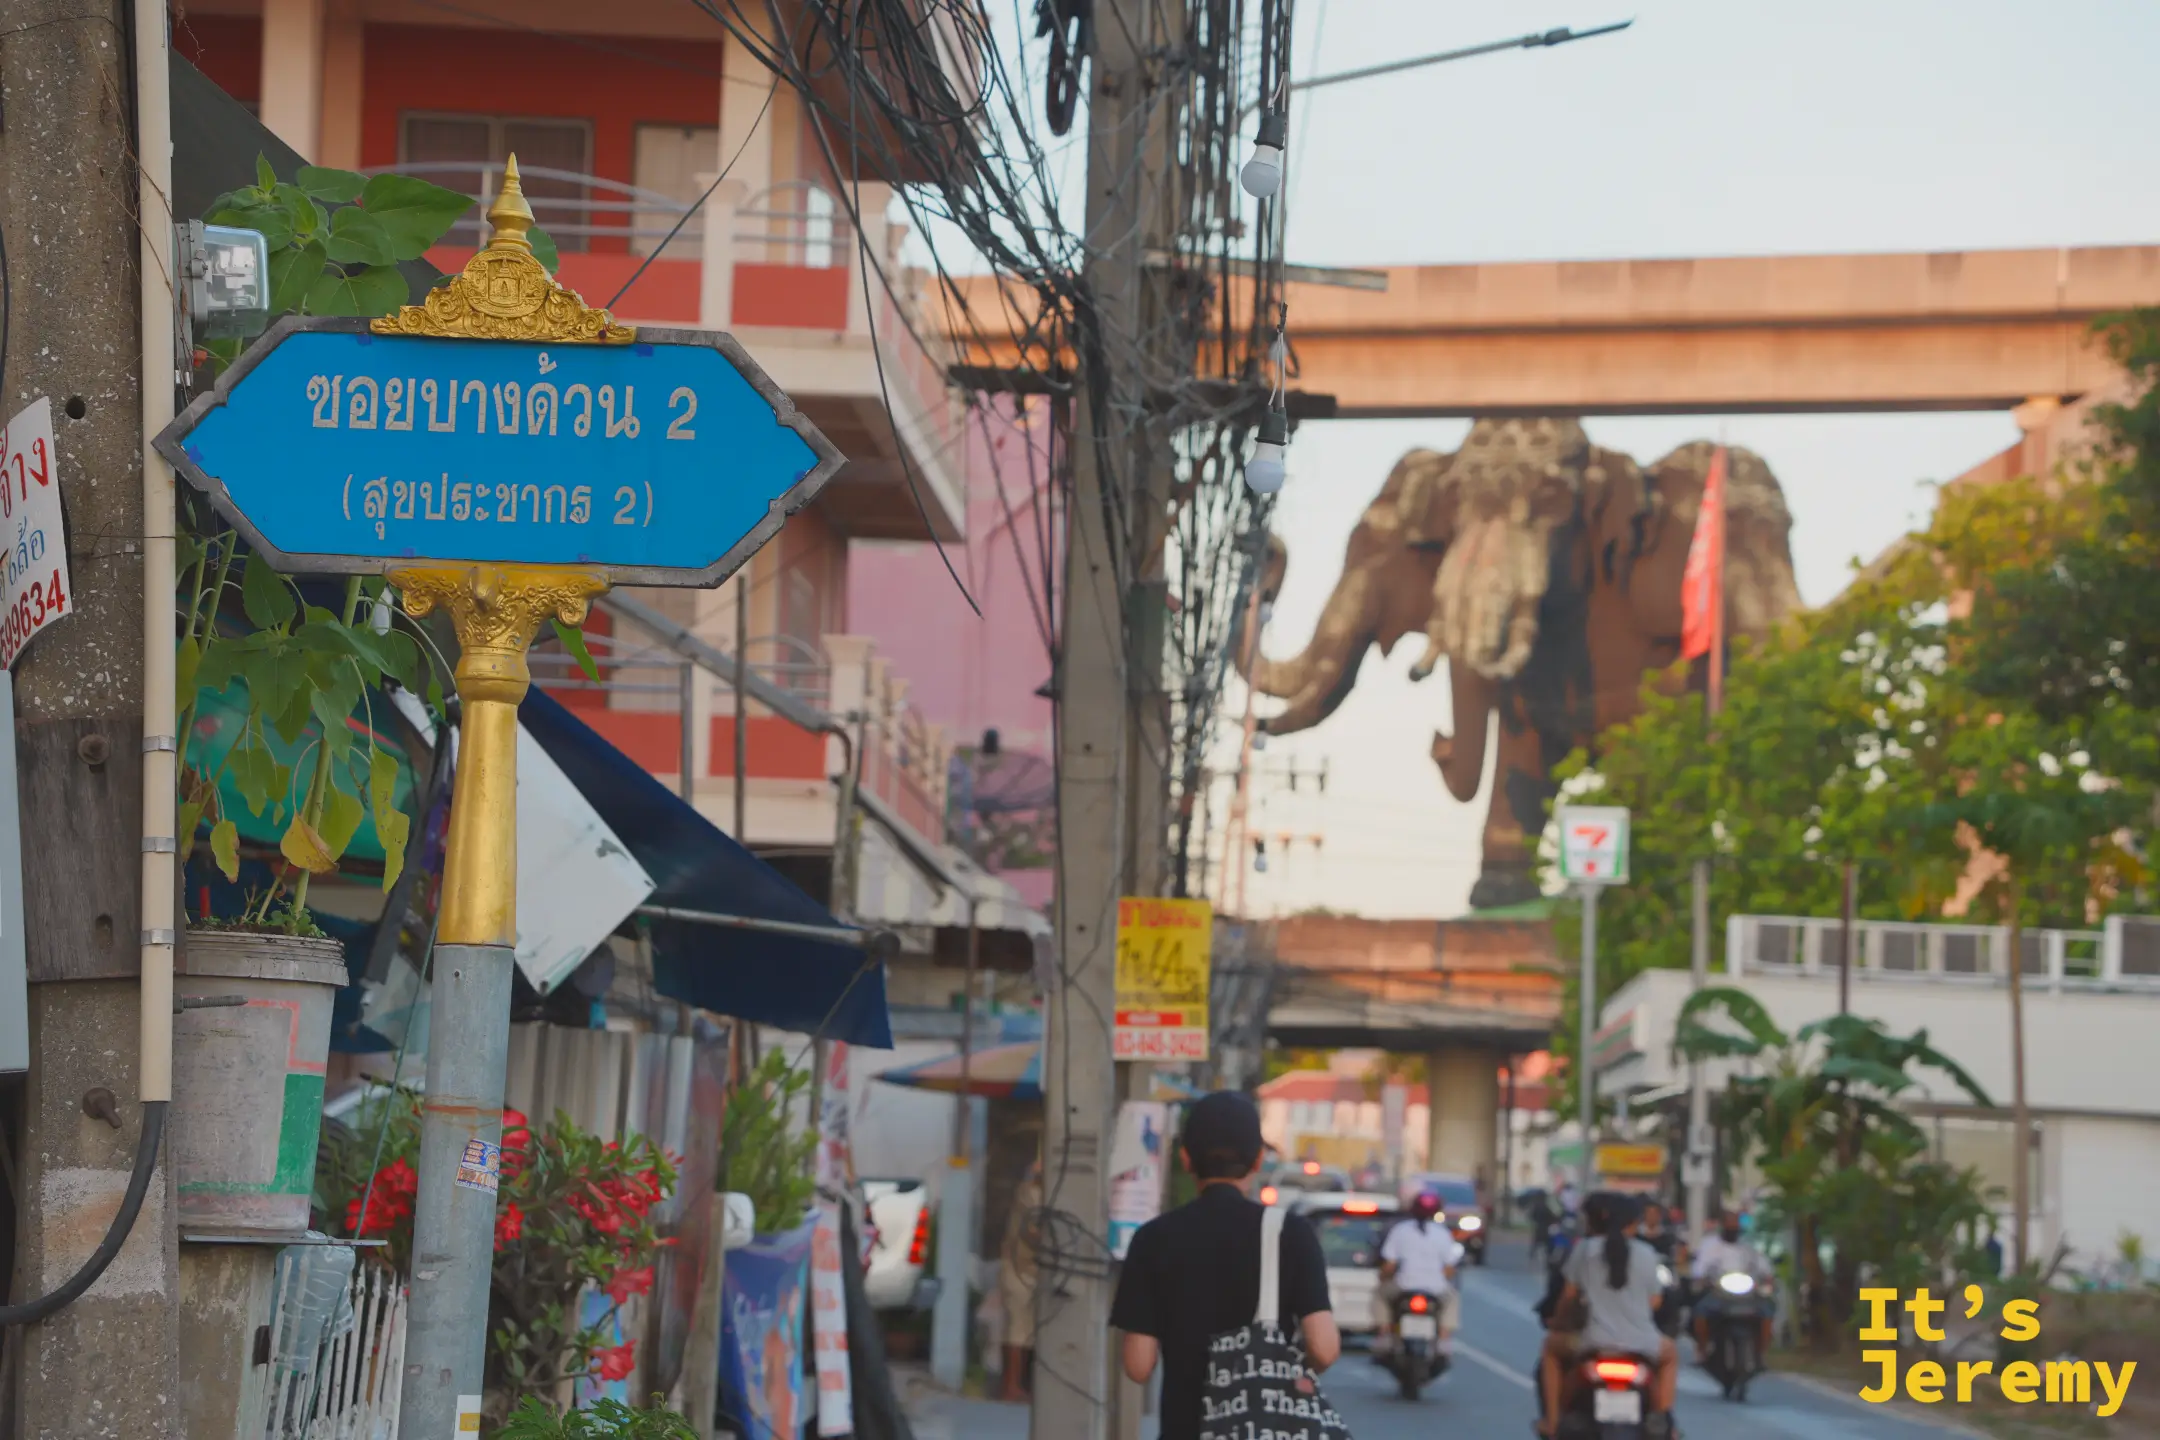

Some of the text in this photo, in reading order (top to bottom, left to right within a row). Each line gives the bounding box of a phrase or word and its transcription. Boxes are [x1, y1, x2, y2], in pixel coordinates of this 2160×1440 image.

[306, 352, 698, 440] ซอยบางด้วน 2
